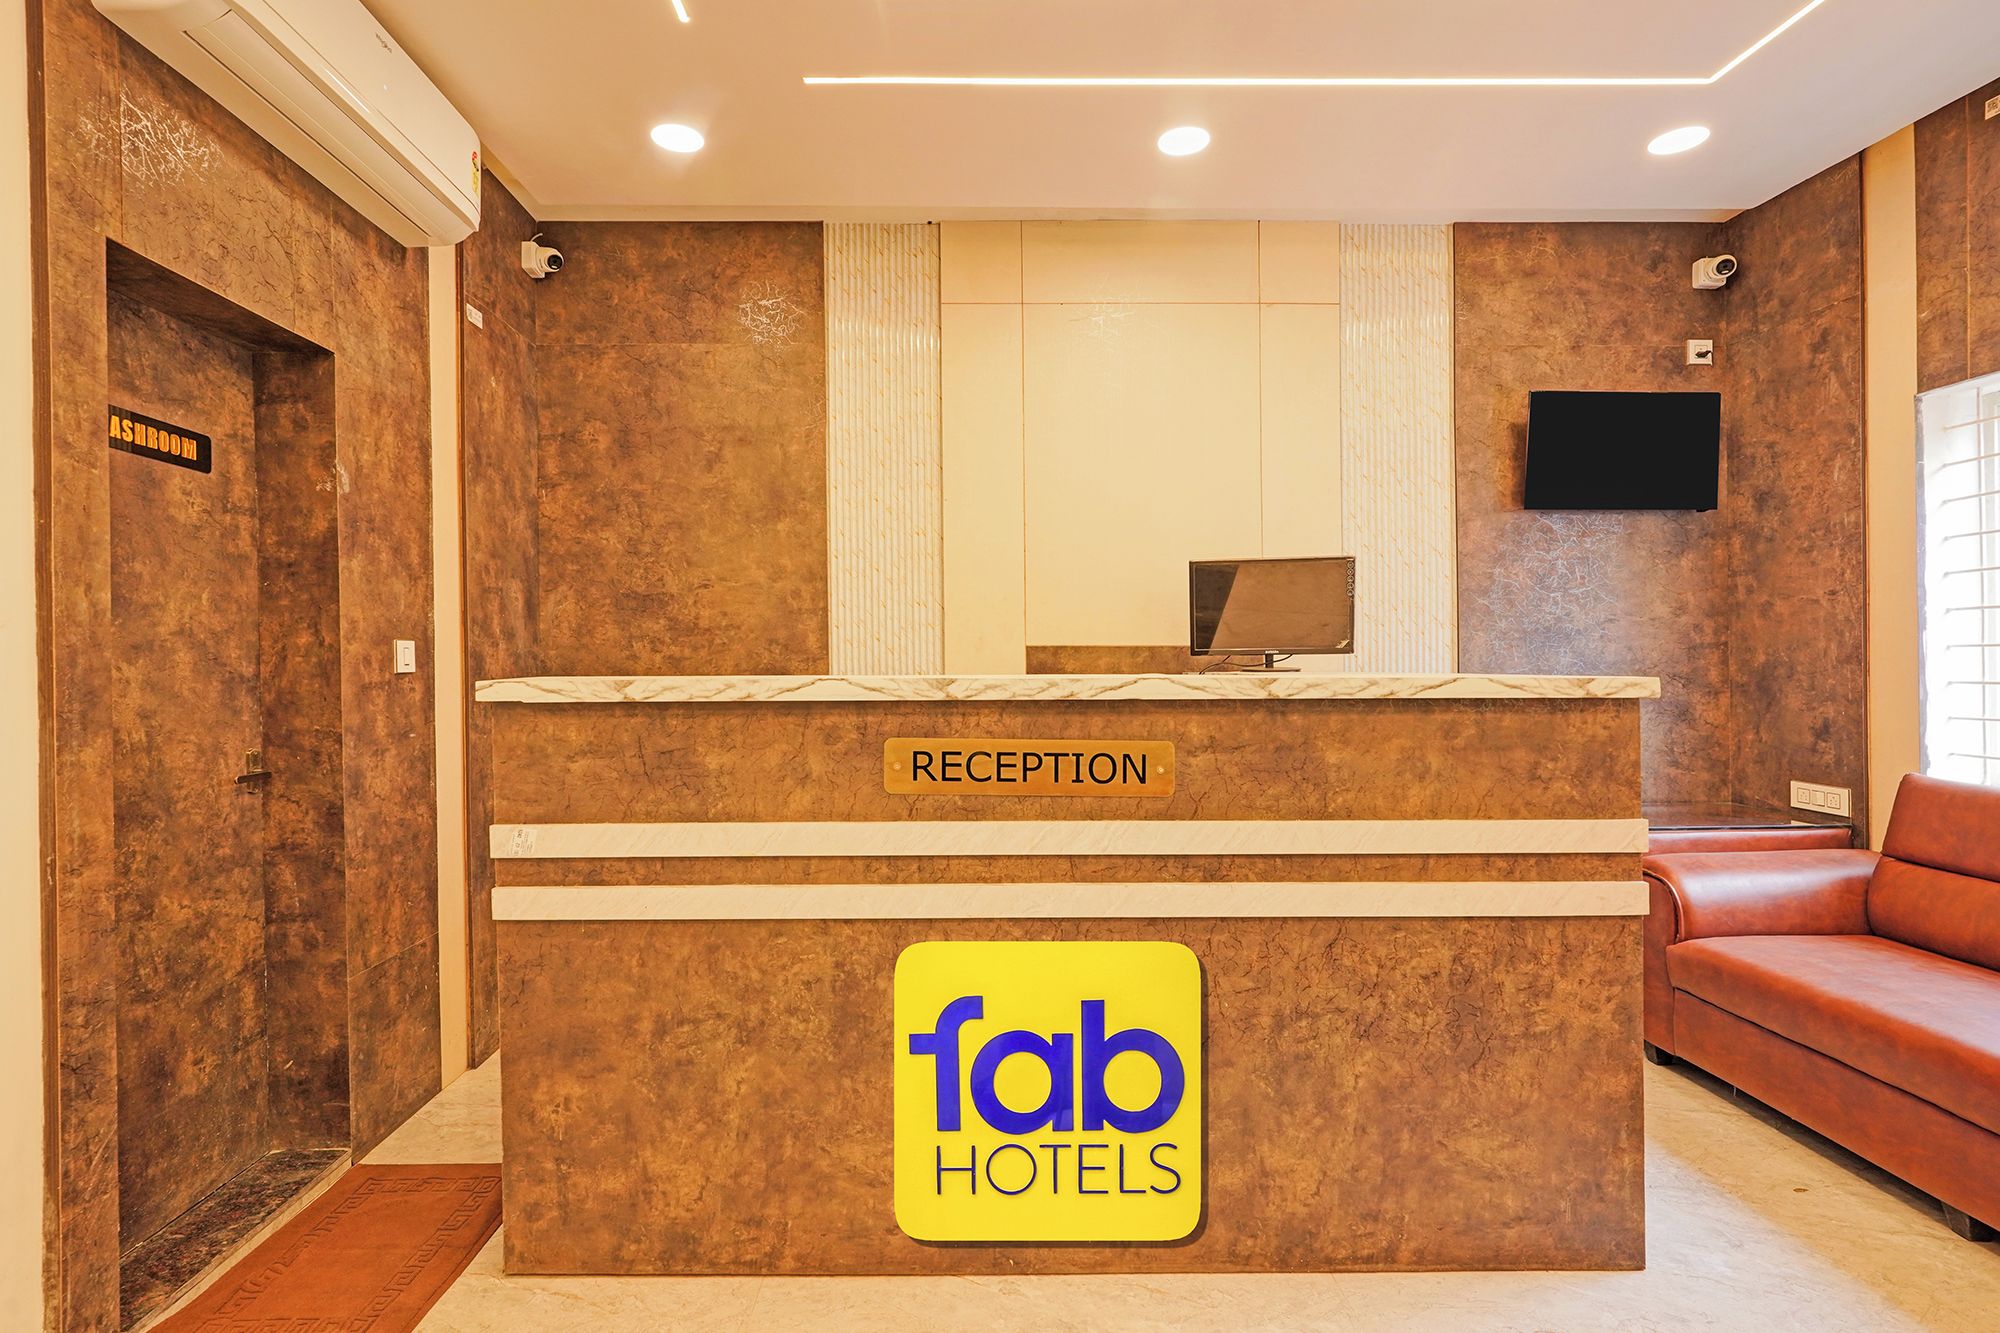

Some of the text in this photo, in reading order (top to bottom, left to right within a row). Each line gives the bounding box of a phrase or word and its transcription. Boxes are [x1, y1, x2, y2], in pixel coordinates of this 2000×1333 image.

[109, 415, 197, 461] ASHROOM
[911, 750, 1147, 785] RECEPTION
[908, 995, 1186, 1135] fab
[936, 1142, 1182, 1195] HOTELS
